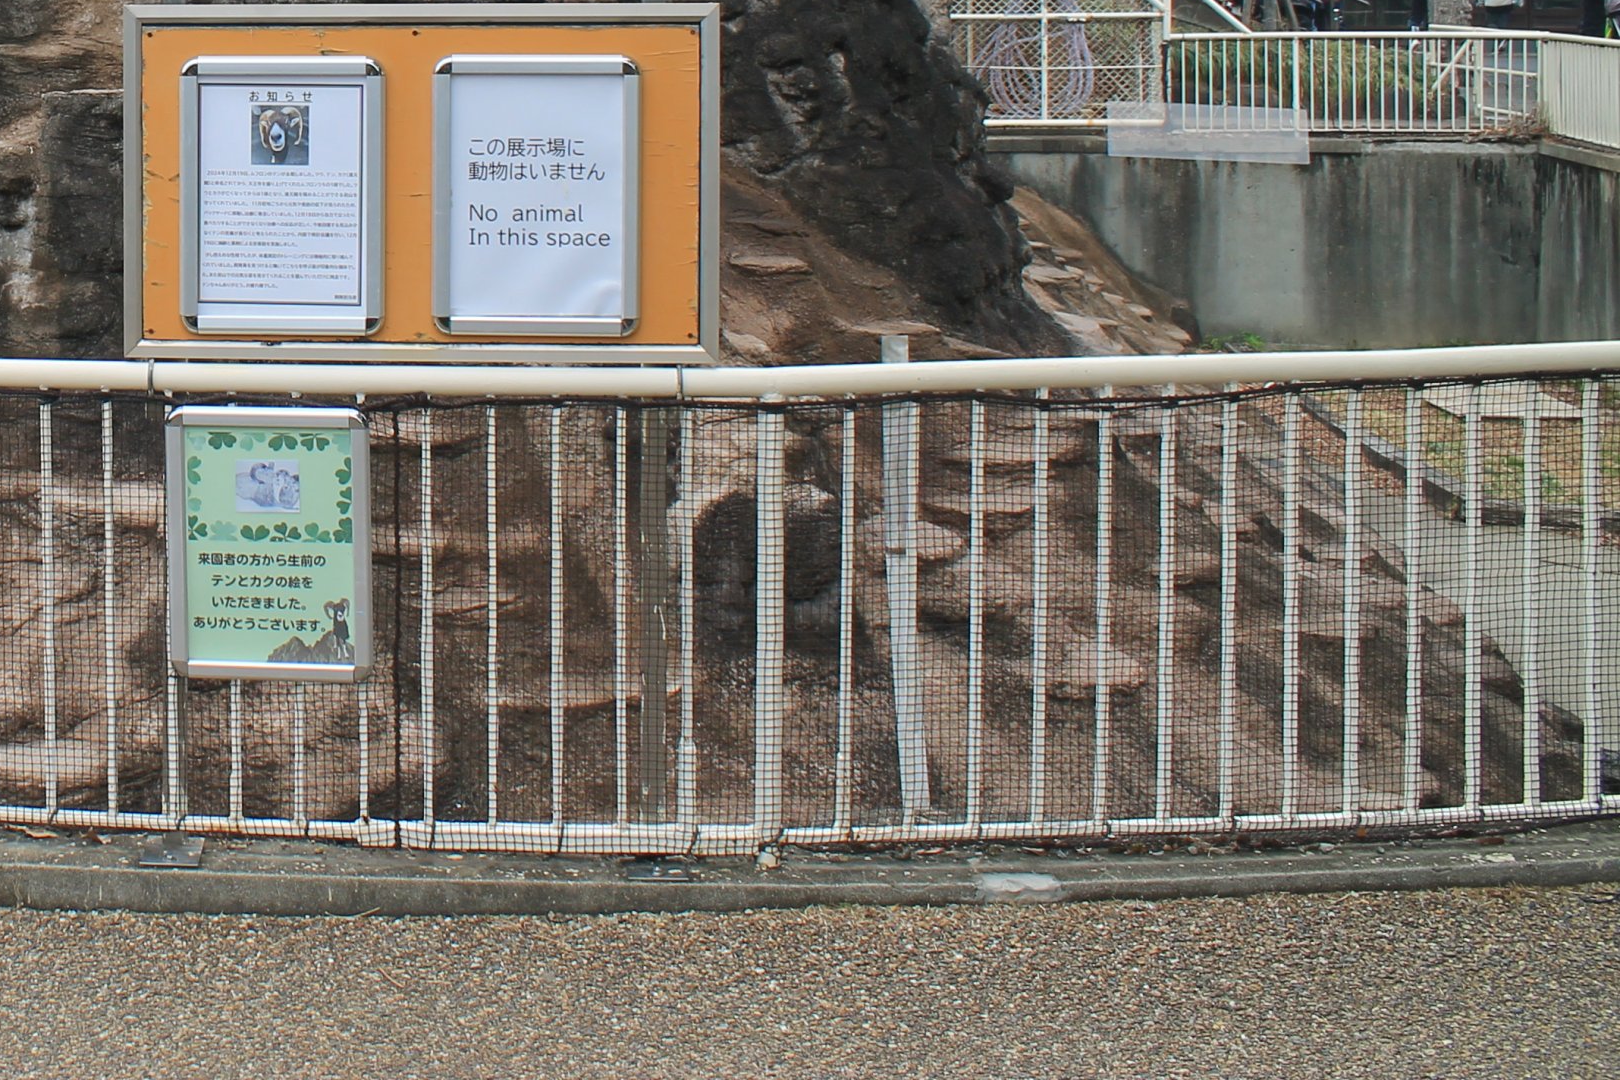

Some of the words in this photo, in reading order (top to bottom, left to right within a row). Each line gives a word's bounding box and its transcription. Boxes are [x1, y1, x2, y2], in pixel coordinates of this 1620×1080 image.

[248, 90, 314, 103] お知らせ
[468, 137, 585, 158] この展示場に
[468, 161, 606, 182] 動物はいません
[468, 204, 499, 222] No
[512, 204, 584, 222] animal
[468, 228, 490, 246] In
[498, 227, 539, 246] this
[546, 231, 612, 248] space
[198, 552, 326, 567] 来園者の方から生前の
[211, 574, 313, 589] テンとカクの絵を
[211, 595, 308, 611] いただきました。
[193, 616, 329, 633] ありがとうございます。
